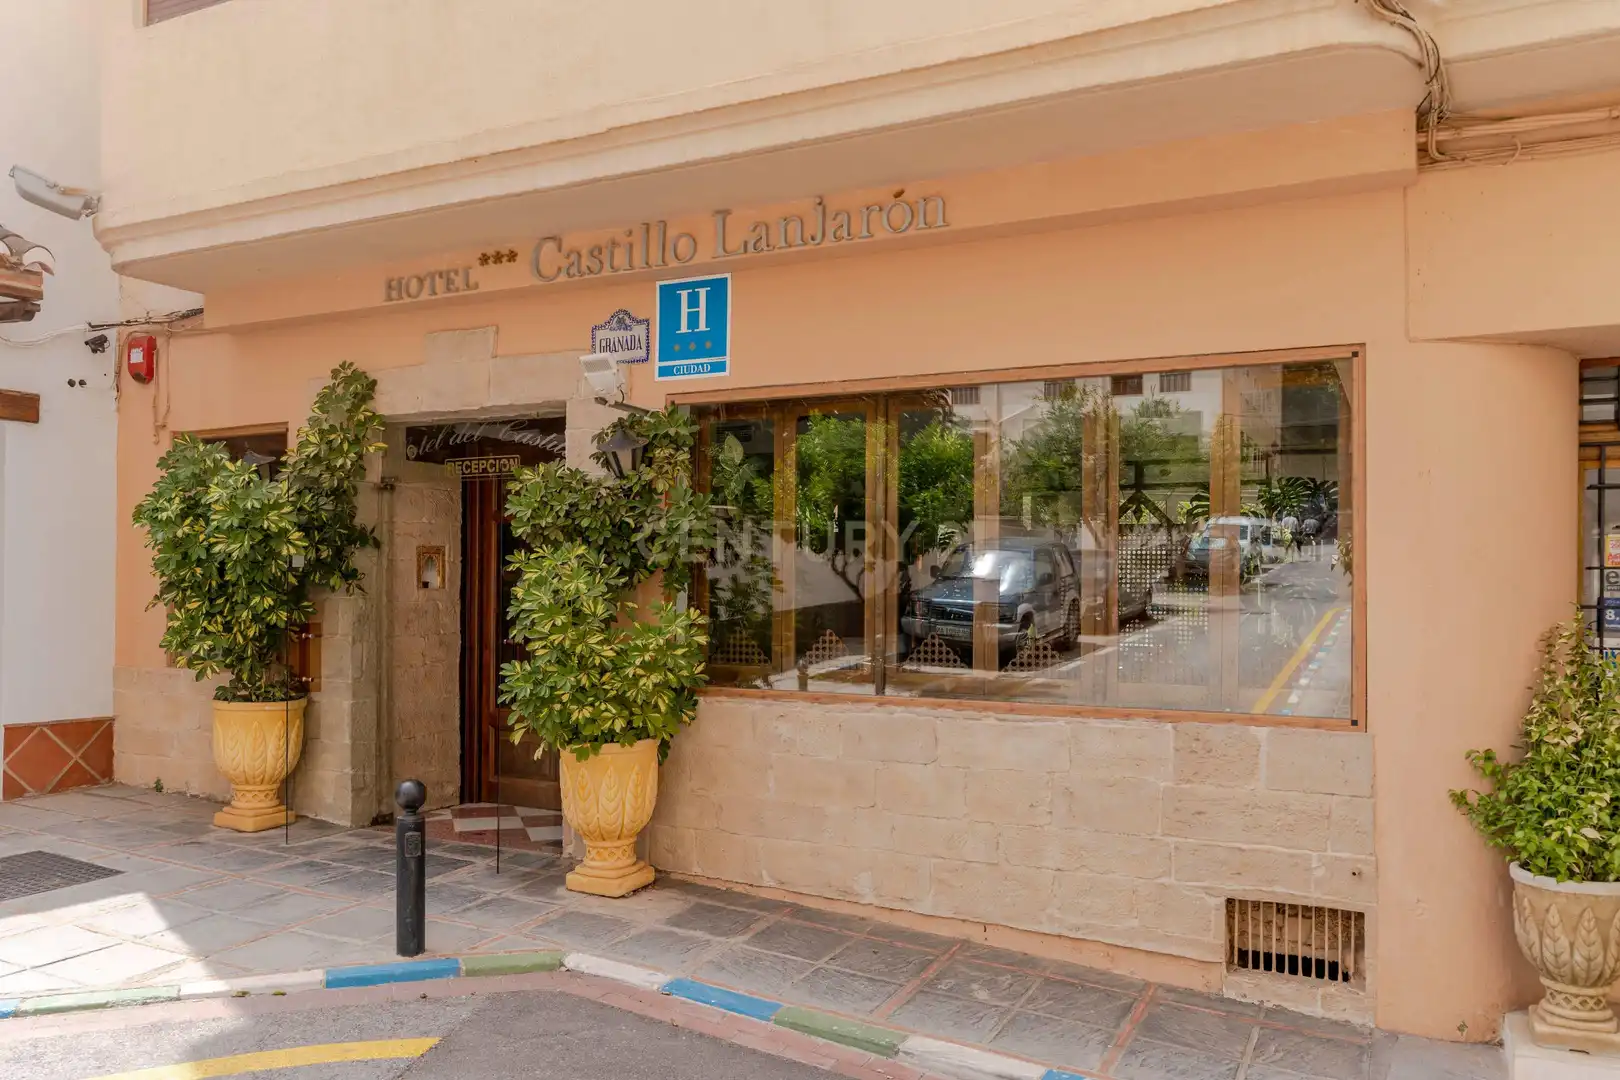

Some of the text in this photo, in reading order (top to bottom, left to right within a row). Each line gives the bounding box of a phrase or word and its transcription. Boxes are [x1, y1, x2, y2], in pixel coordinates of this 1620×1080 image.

[384, 188, 950, 301] HOTEL Castillo Lanjarón
[676, 287, 711, 334] H
[599, 334, 642, 354] GRANADA
[673, 363, 711, 375] CIUDAD
